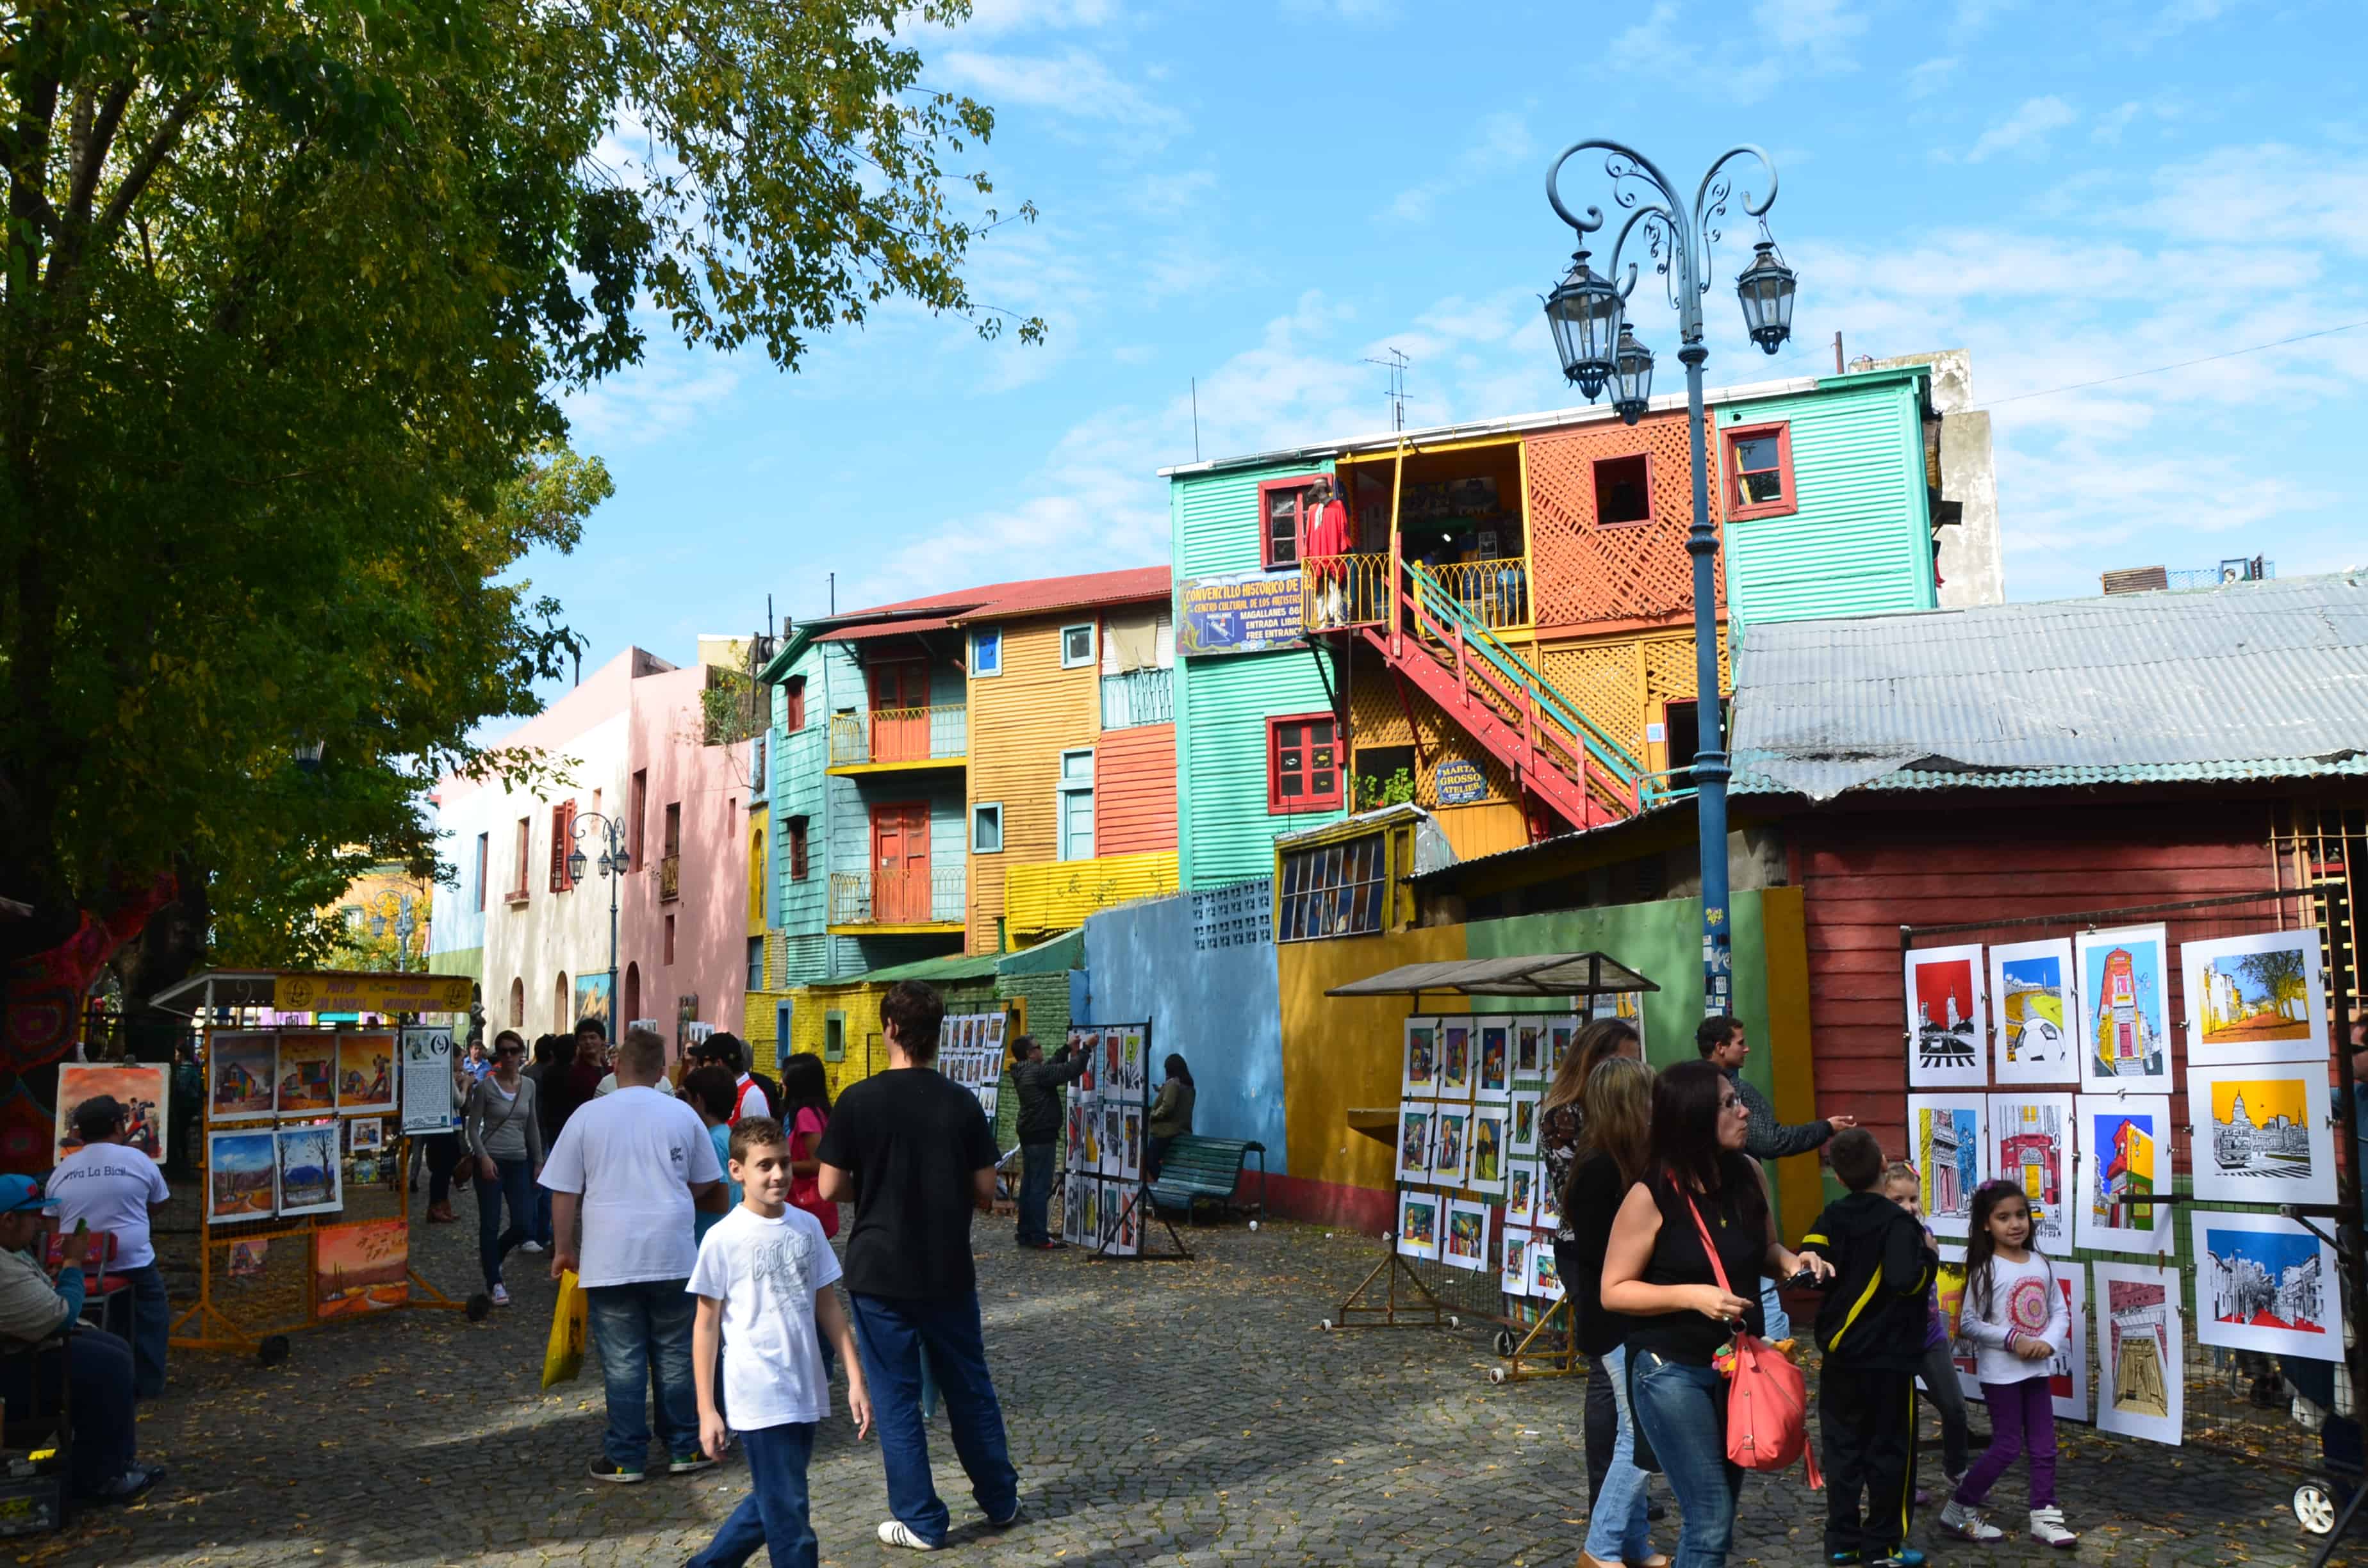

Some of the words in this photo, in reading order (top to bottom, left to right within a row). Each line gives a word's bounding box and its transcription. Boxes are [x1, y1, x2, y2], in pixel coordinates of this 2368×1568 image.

[1185, 585, 1241, 603] CONVENTILLO
[1242, 580, 1285, 598] HISTORICO
[1286, 578, 1298, 592] DE
[1259, 597, 1270, 607] LOS
[1240, 607, 1287, 620] MAGALLANES
[1246, 619, 1279, 630] ENTRADA
[1281, 616, 1302, 626] LIBRE
[1246, 630, 1263, 639] FREE
[1442, 765, 1476, 776] MARTA
[1440, 772, 1481, 786] GROSSO
[1442, 781, 1481, 794] ATELIER
[88, 1166, 101, 1177] La
